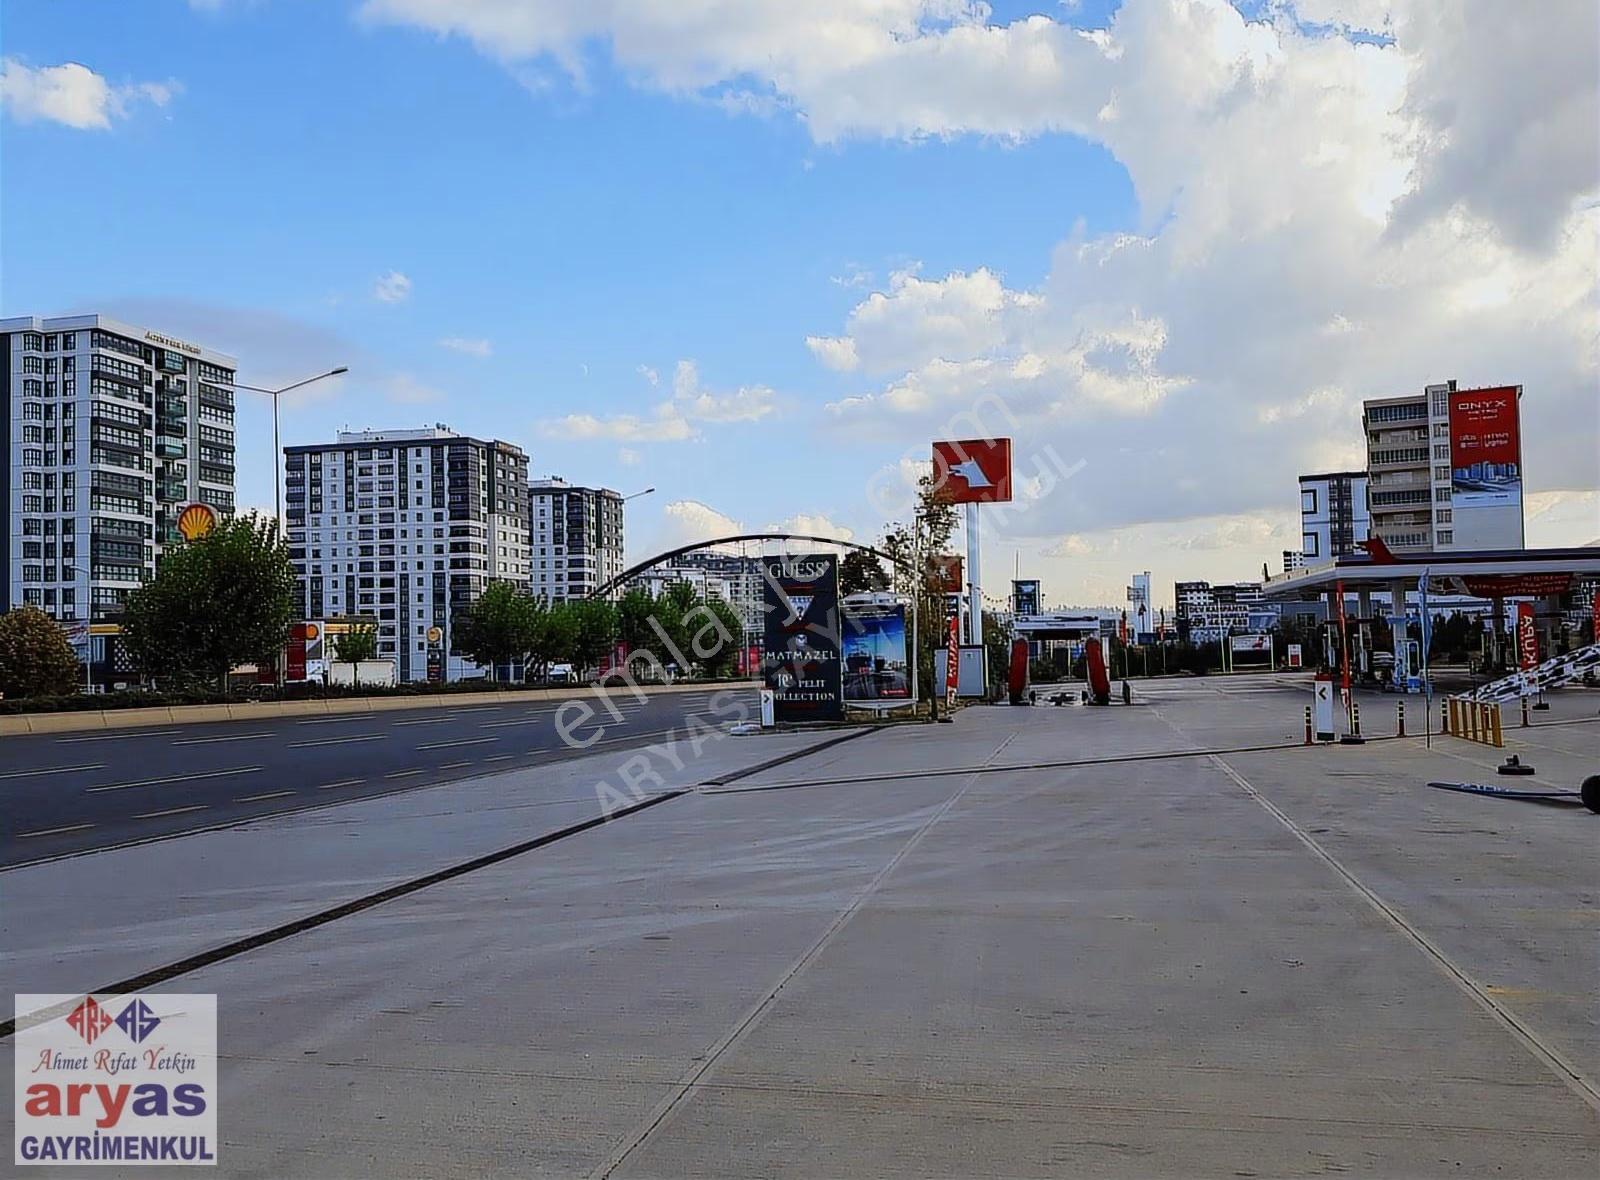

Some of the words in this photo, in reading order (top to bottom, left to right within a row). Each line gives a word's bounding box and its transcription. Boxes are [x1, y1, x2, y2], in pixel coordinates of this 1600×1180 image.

[1458, 400, 1507, 410] ONYX
[769, 561, 825, 579] GUESS
[766, 650, 838, 660] MATMAZEL
[774, 692, 835, 701] OLLECTION
